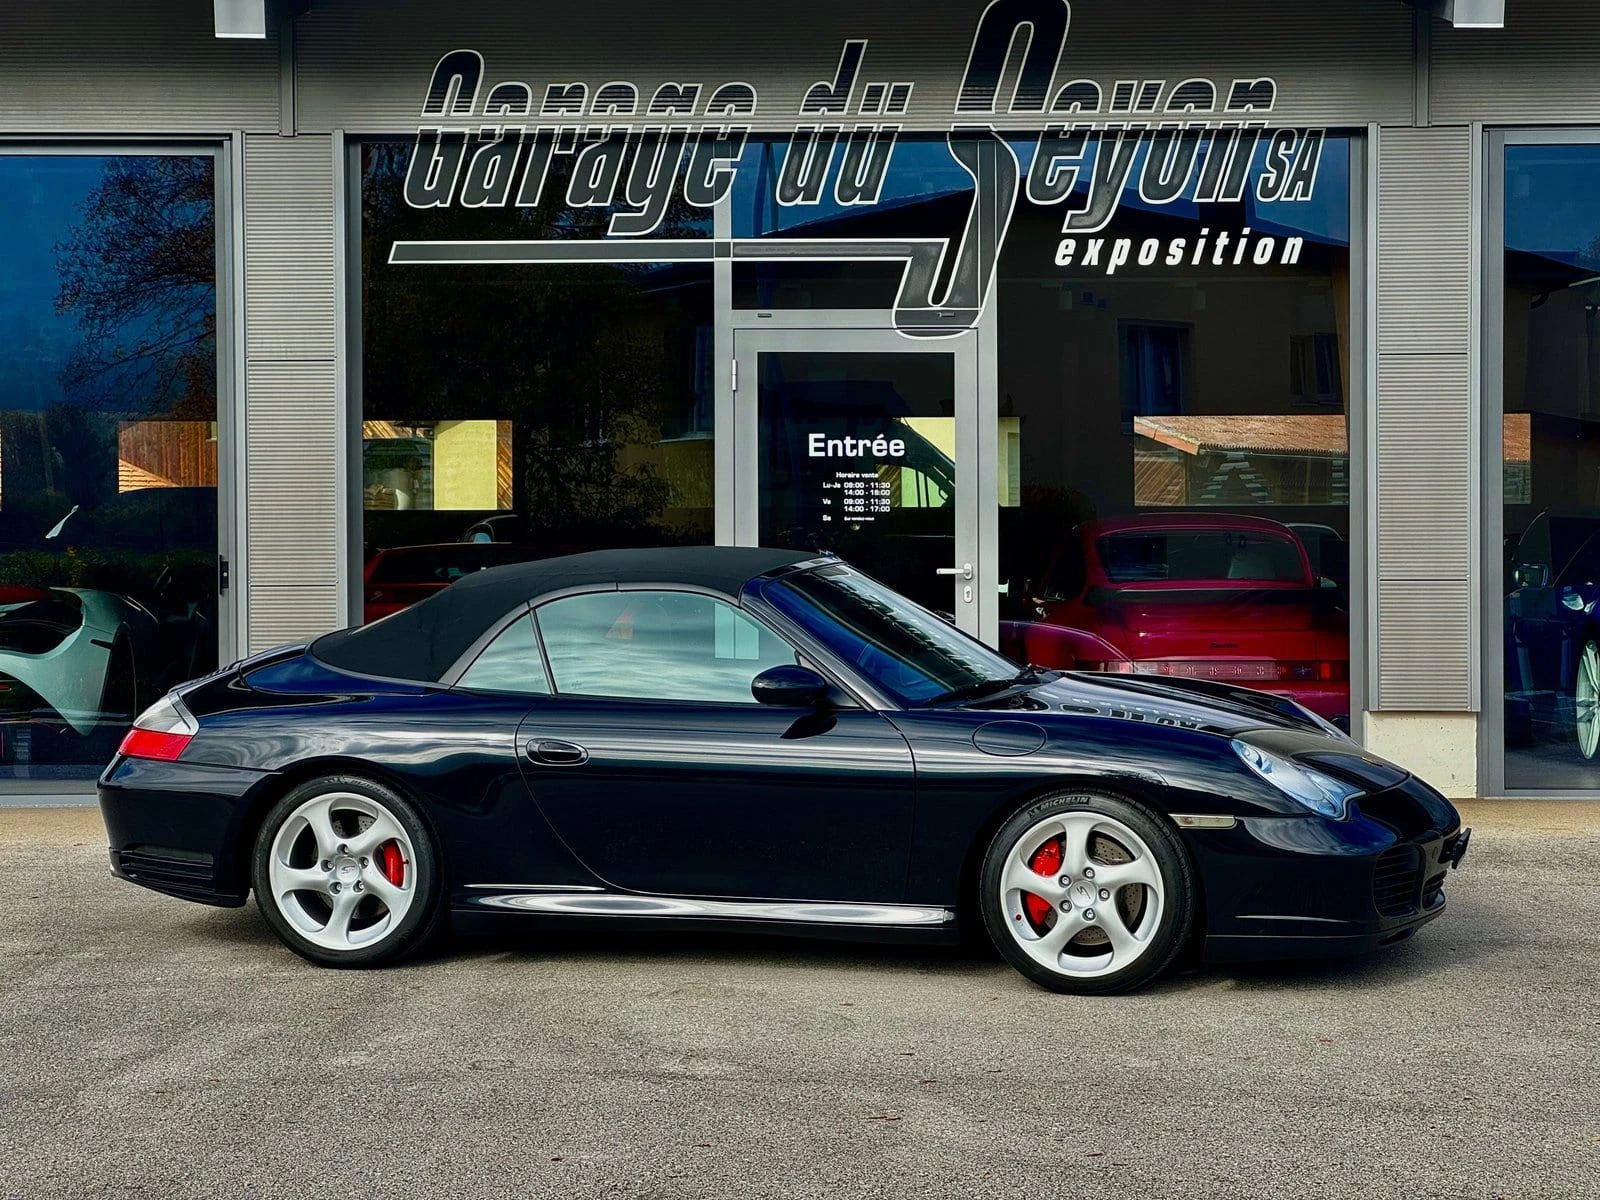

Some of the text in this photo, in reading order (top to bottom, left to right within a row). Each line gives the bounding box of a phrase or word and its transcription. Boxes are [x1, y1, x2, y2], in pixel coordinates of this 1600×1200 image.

[403, 0, 1326, 339] Garage du Seyon SA
[1054, 228, 1304, 275] exposition
[808, 433, 905, 457] Entrée
[1040, 796, 1089, 810] MICHELIN
